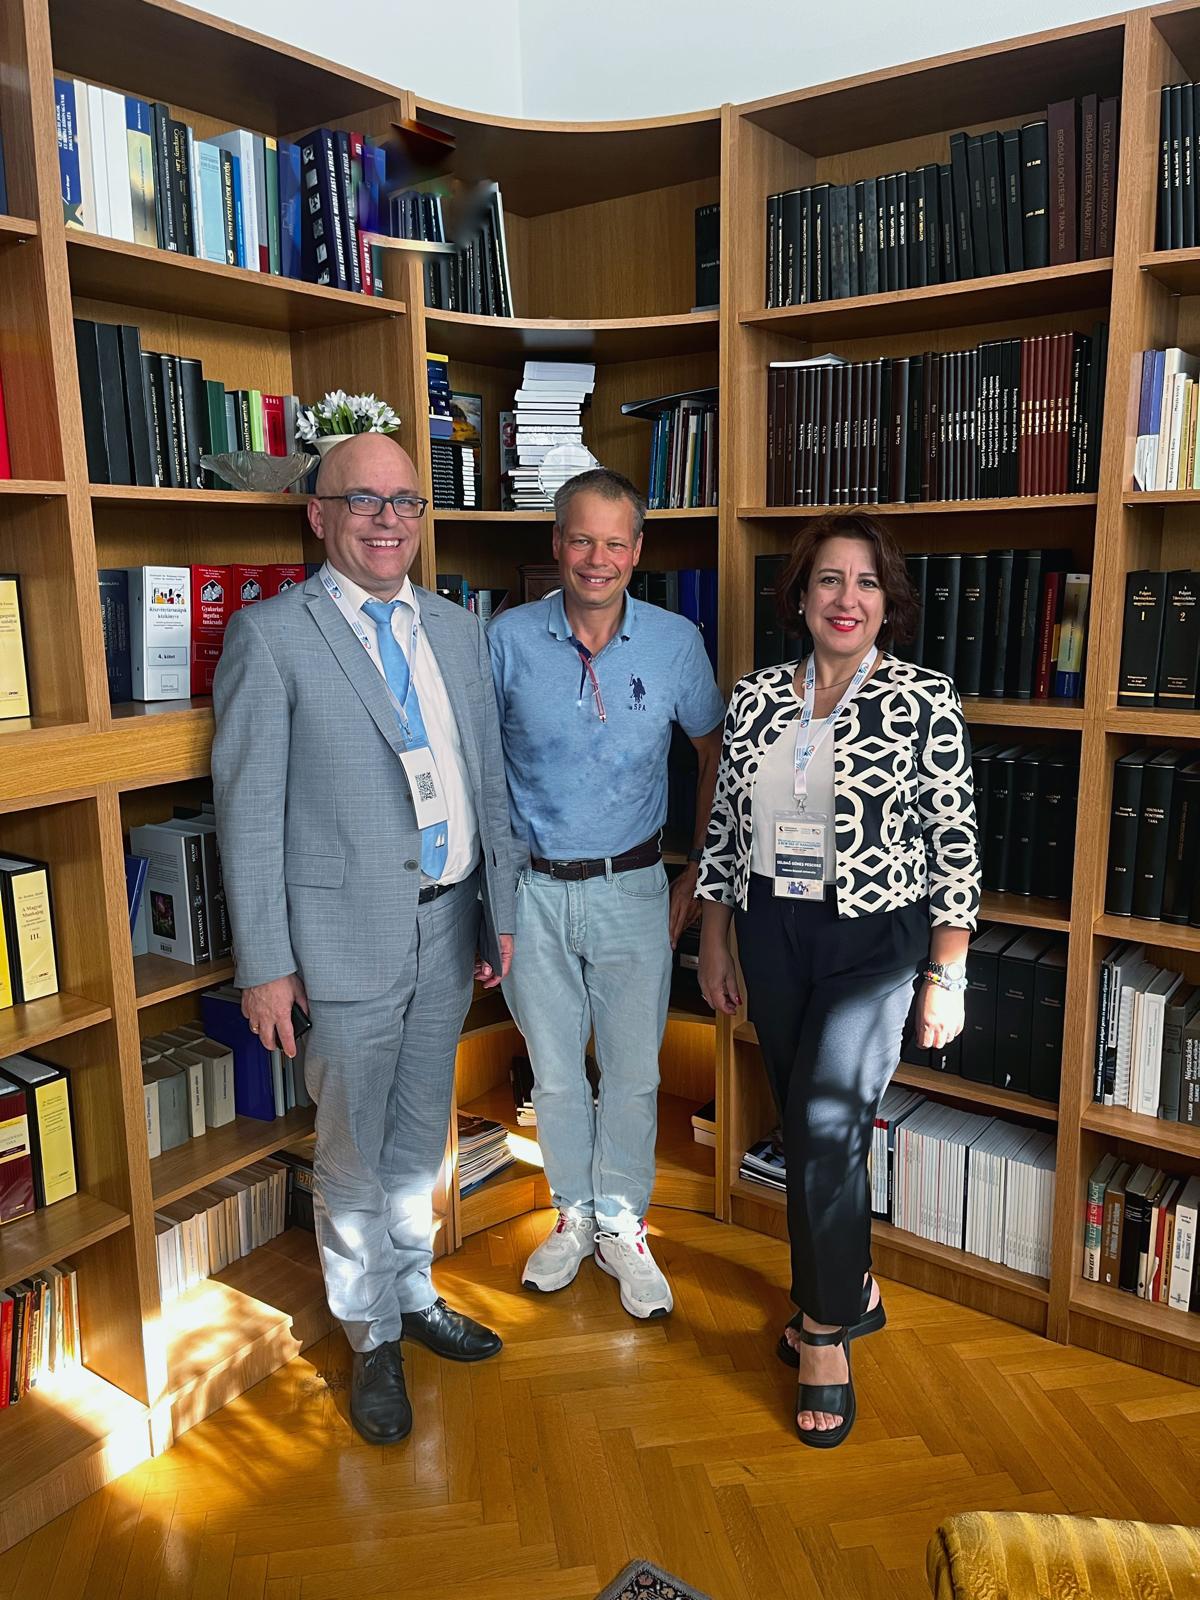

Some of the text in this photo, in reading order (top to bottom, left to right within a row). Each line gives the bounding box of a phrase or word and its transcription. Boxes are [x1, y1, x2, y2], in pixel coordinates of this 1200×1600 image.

[327, 151, 335, 172] AFRICA
[336, 239, 345, 263] EXPERTS
[351, 242, 359, 266] EXPERTS
[1180, 611, 1186, 622] 2
[197, 910, 205, 947] DOCUMENTA
[1184, 1038, 1193, 1080] Népszokások
